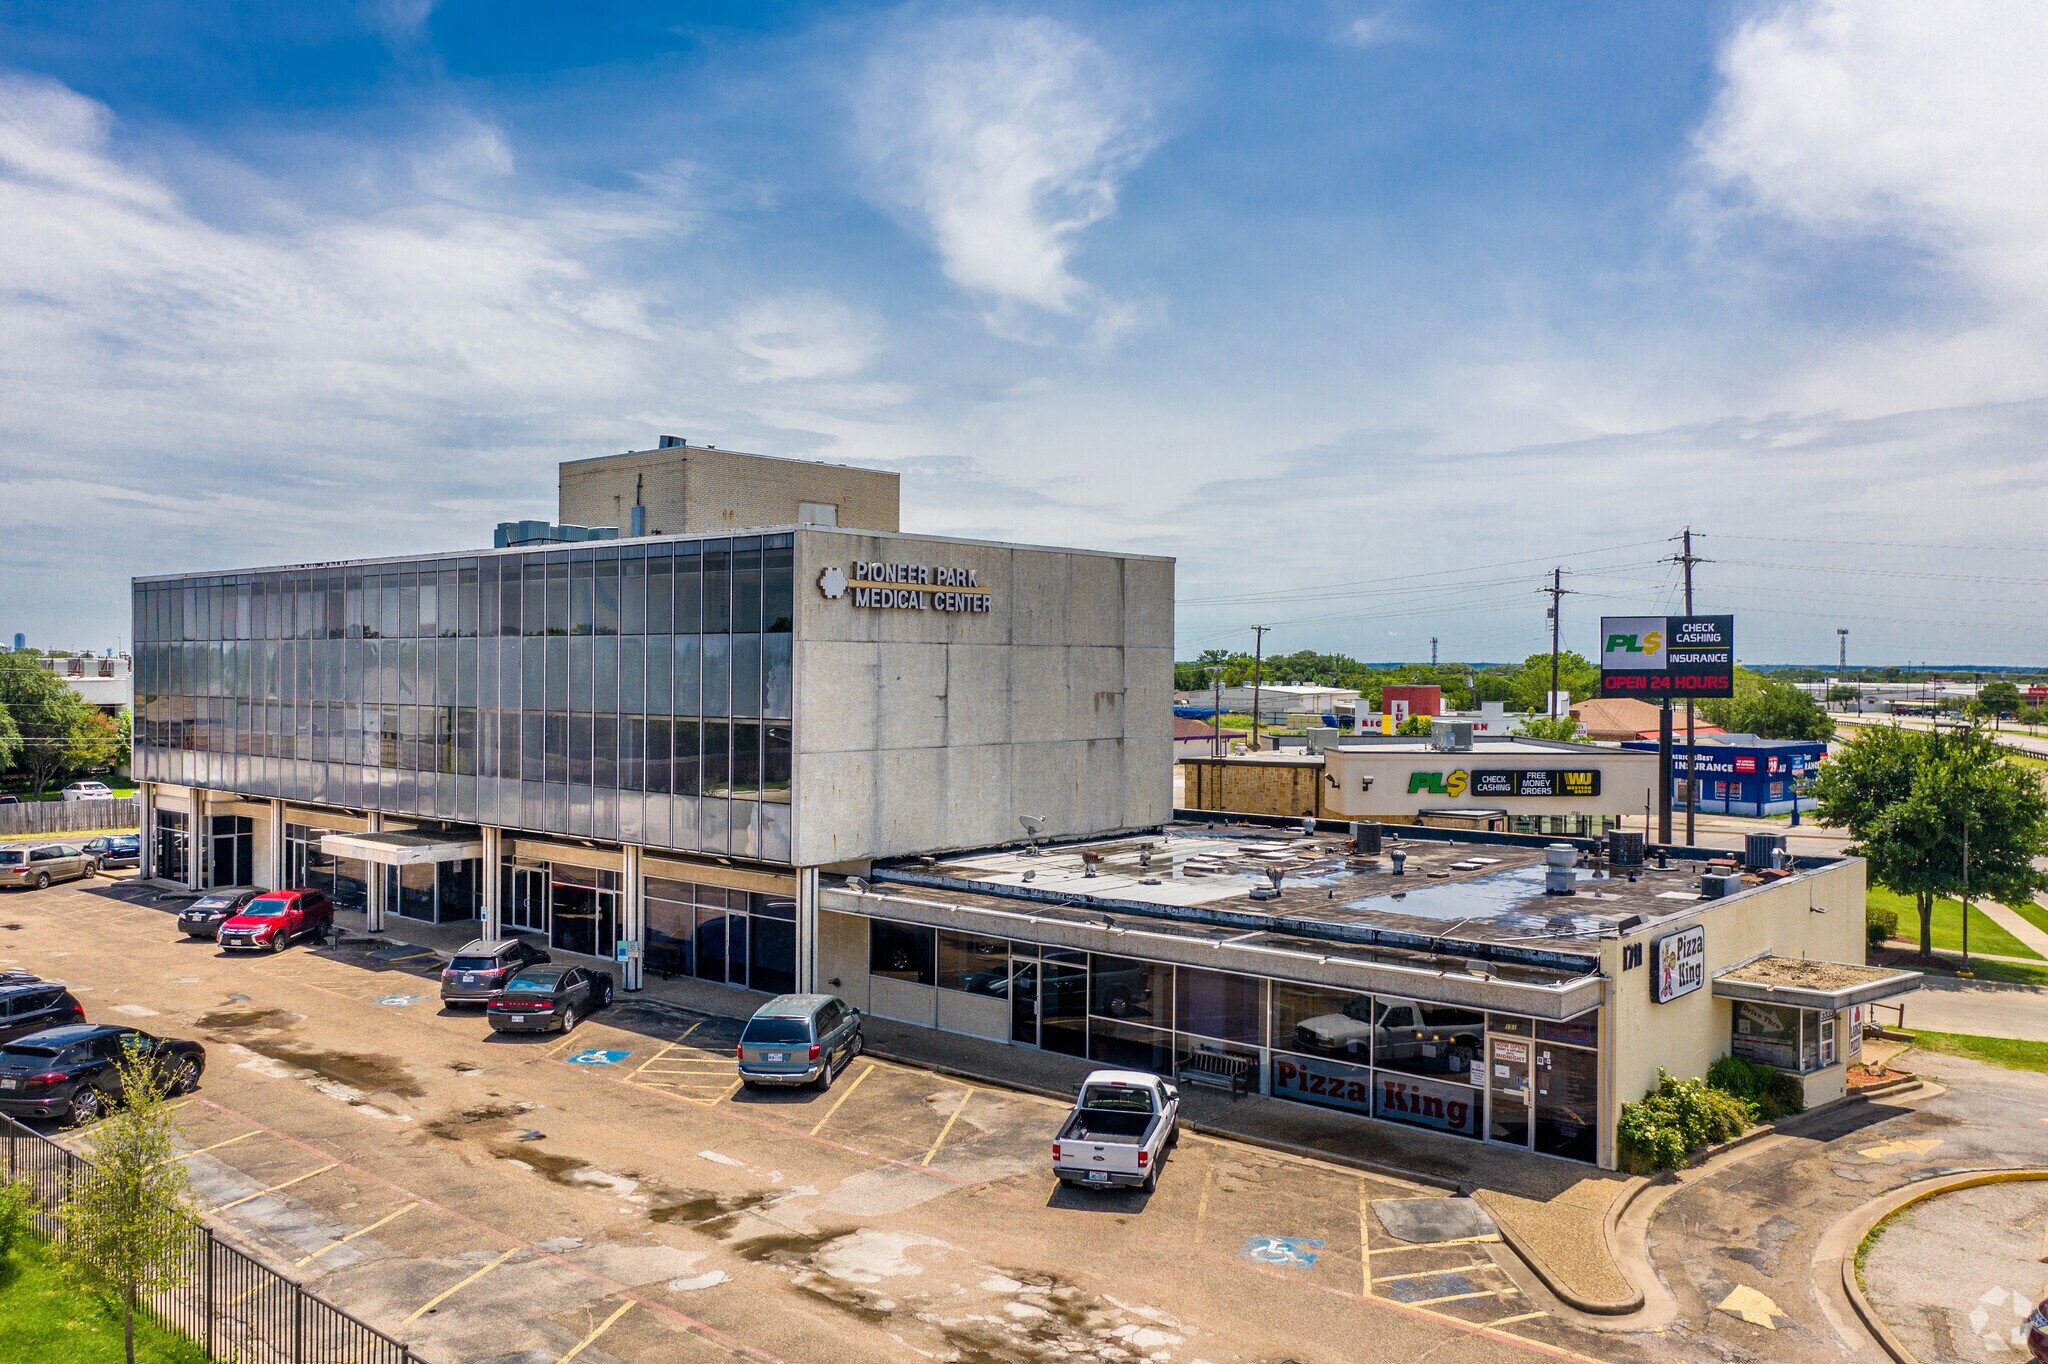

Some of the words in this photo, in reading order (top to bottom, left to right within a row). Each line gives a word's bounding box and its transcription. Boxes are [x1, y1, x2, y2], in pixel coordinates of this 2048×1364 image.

[855, 561, 929, 585] PIONEER
[936, 567, 979, 588] PARK
[855, 588, 928, 610] MEDICAL
[934, 593, 992, 613] CENTER
[1682, 623, 1715, 633] CHECK
[1676, 633, 1721, 643] CASHING
[1669, 653, 1728, 663] INSURANCE
[1605, 676, 1647, 690] OPEN
[1651, 676, 1671, 690] 24
[1675, 675, 1729, 690] HOURS
[1481, 775, 1507, 784] CHECK
[1526, 771, 1547, 780] FREE
[1477, 783, 1511, 792] CASHING
[1522, 779, 1551, 787] MONEY
[1520, 787, 1553, 795] ORDERS
[1676, 935, 1703, 961] Pizza
[1678, 961, 1702, 988] King
[1743, 1004, 1762, 1019] Drive
[1764, 1015, 1781, 1030] Thru
[1495, 1041, 1509, 1049] NOW
[1510, 1043, 1526, 1051] OPEN
[1495, 1052, 1525, 1062] MIDNIGHT
[1276, 1060, 1367, 1104] Pizza
[1383, 1080, 1469, 1129] King
